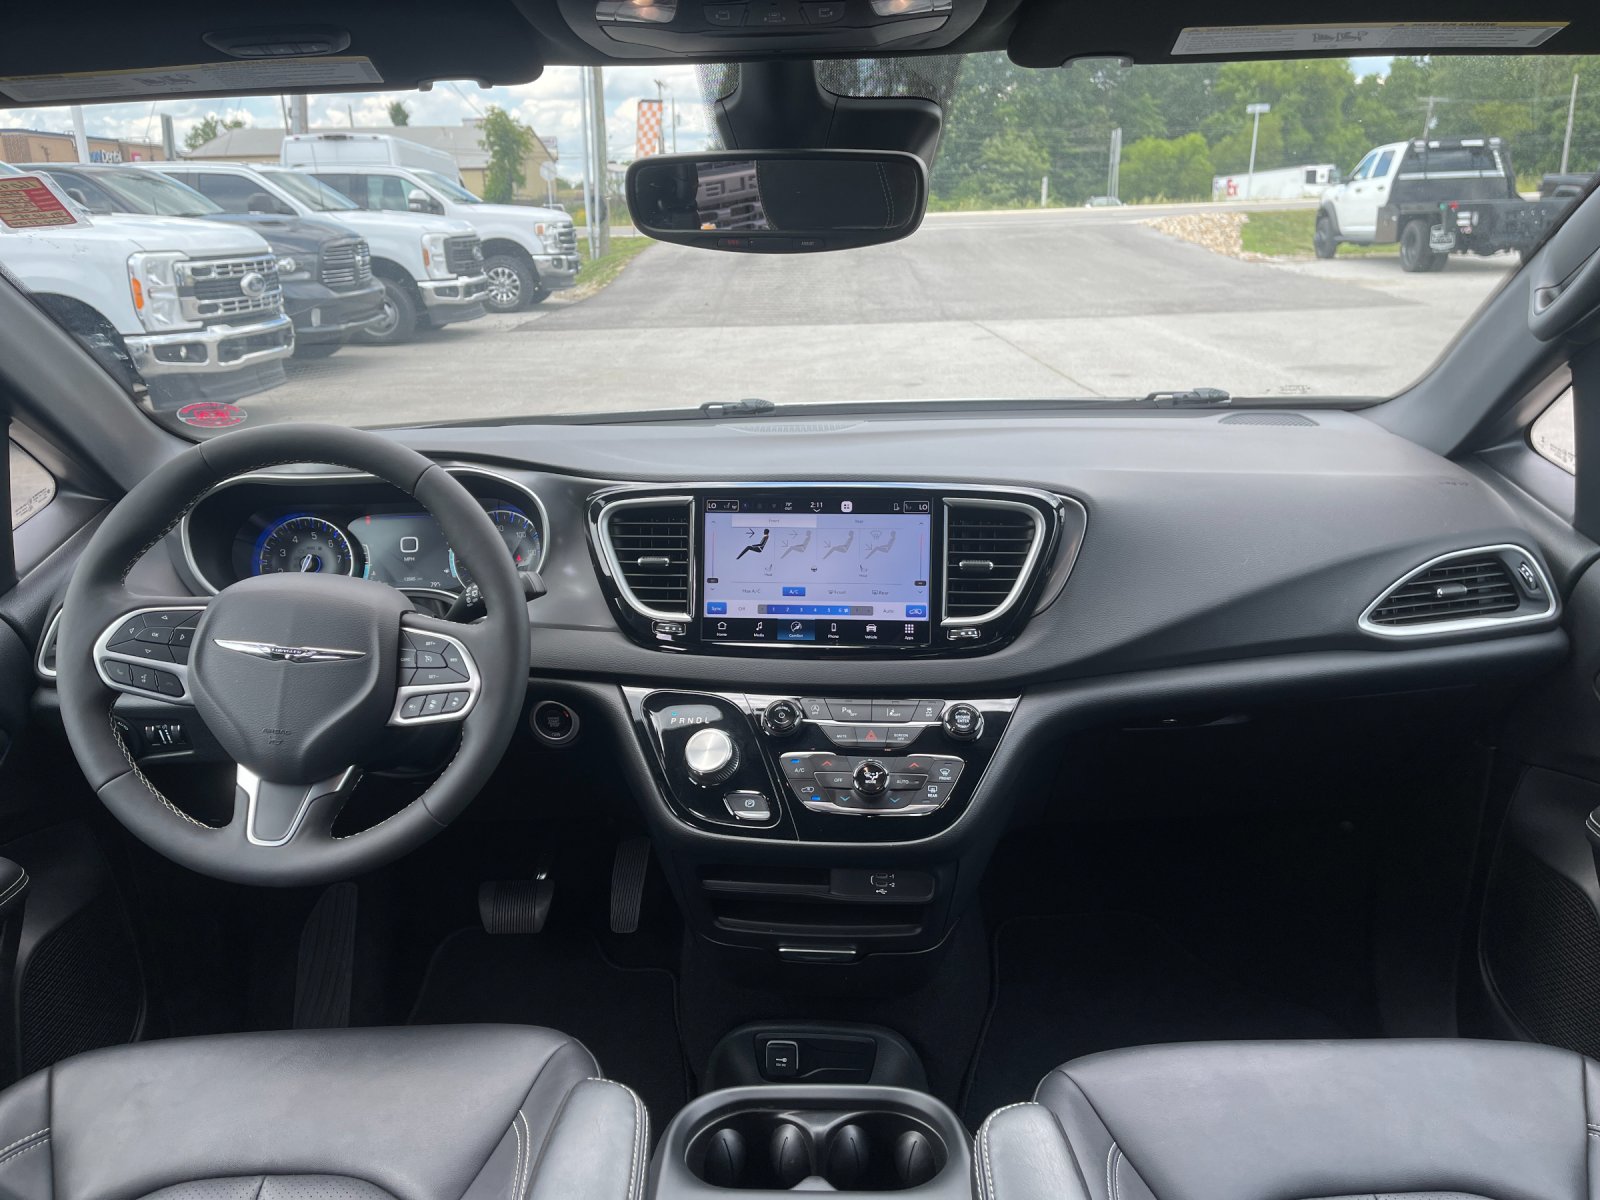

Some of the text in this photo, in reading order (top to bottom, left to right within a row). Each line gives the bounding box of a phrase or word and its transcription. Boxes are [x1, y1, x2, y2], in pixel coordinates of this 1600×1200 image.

[708, 502, 717, 510] LO
[810, 501, 823, 509] 2:11
[918, 503, 928, 511] LO
[292, 535, 298, 543] 4
[311, 531, 318, 540] 5
[328, 539, 334, 548] 6
[279, 548, 286, 557] 3
